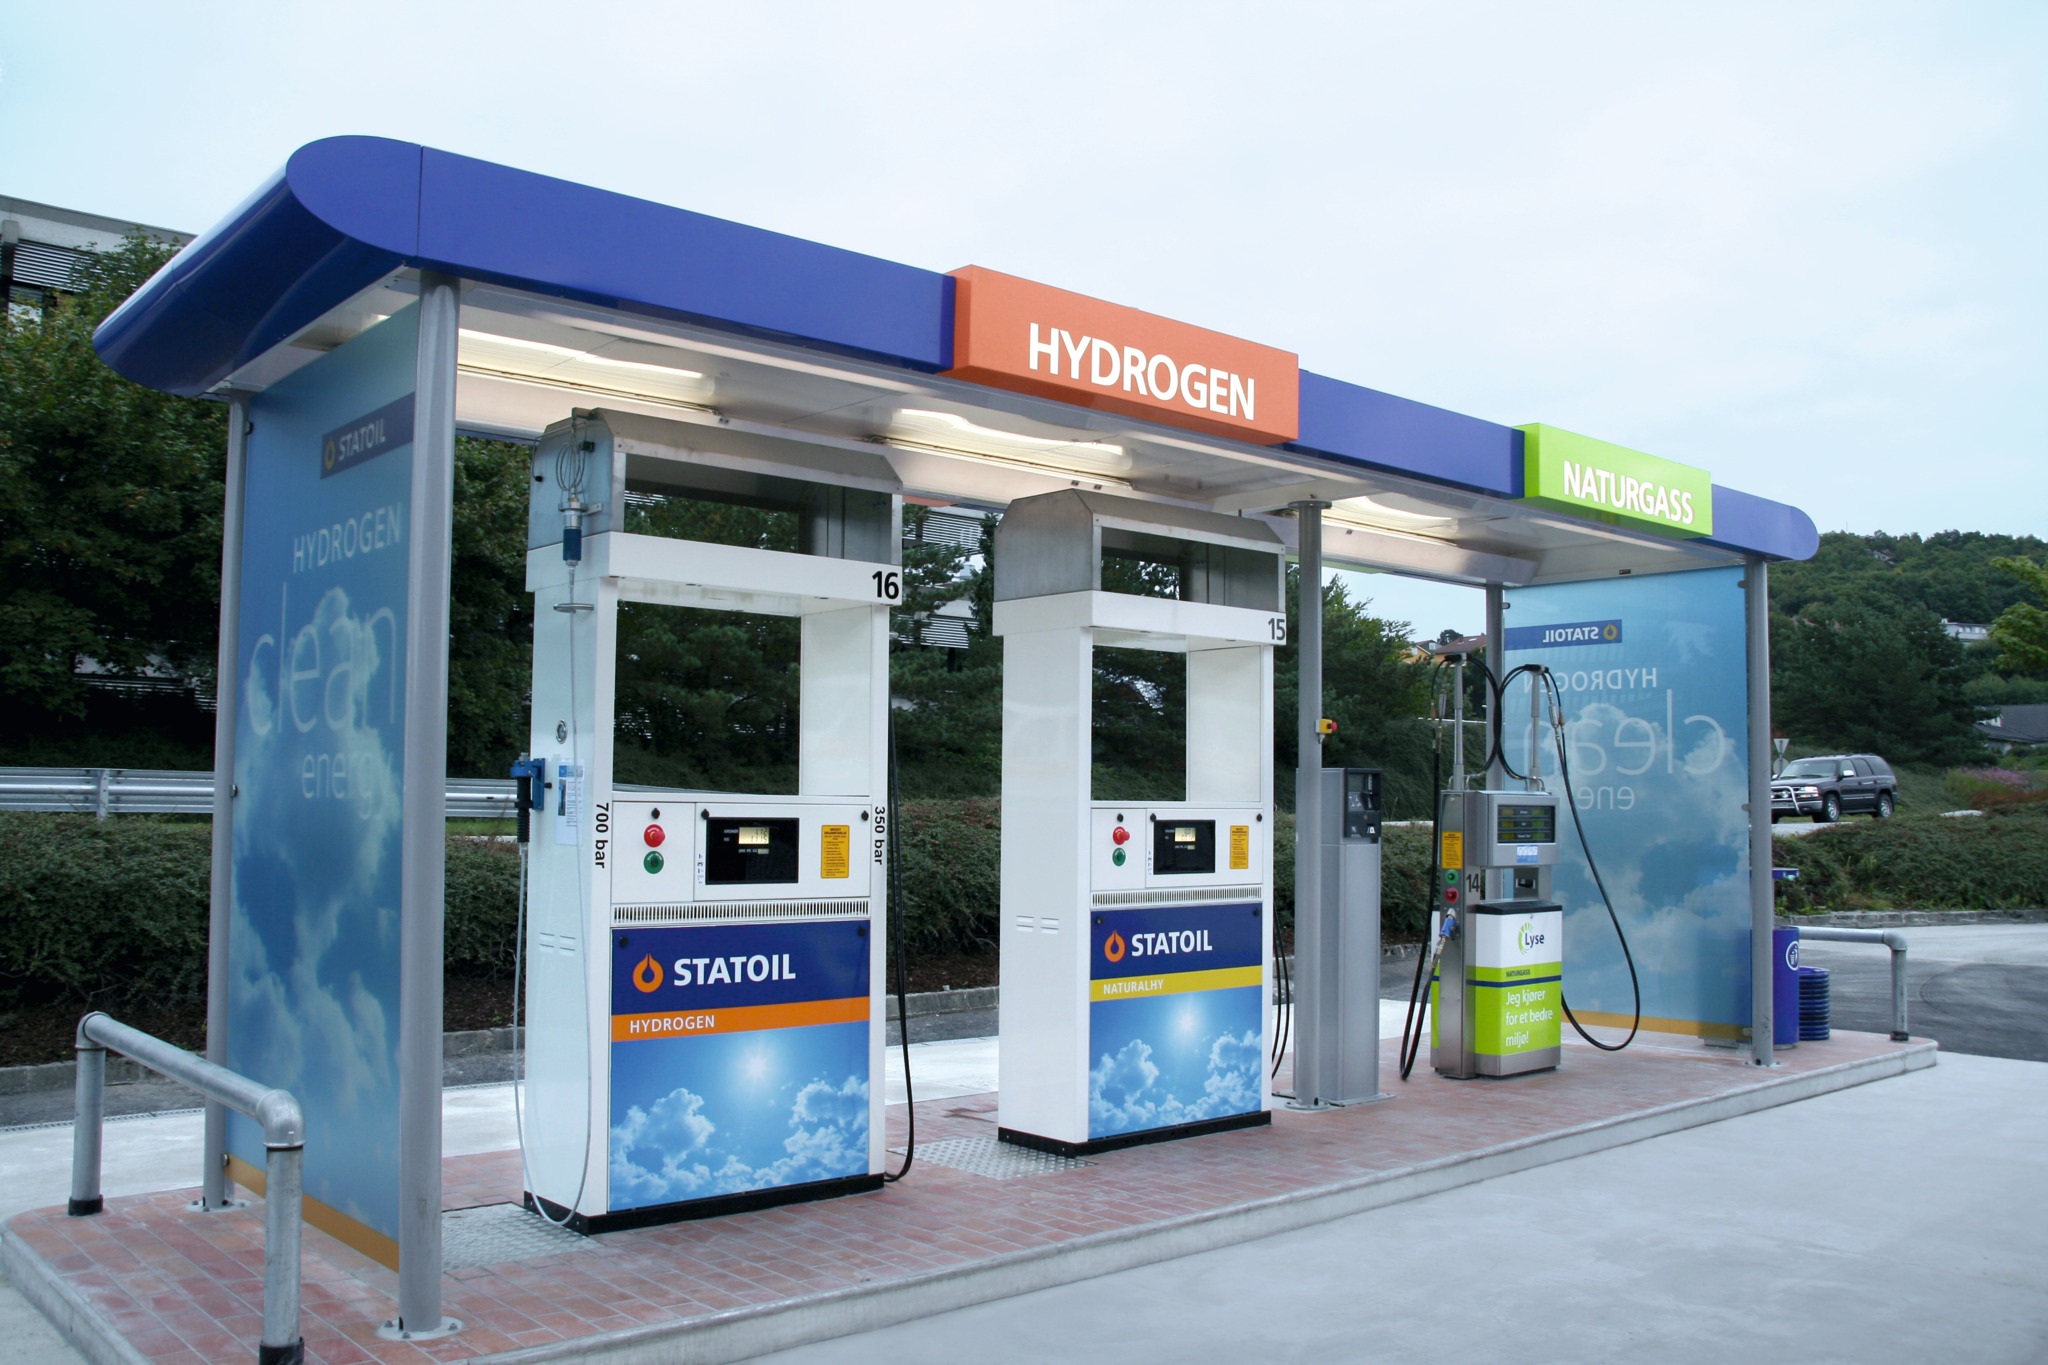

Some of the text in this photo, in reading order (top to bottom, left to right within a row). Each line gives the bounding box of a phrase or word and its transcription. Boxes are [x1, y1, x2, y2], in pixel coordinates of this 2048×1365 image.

[1028, 321, 1256, 422] HYDROGEN
[338, 419, 386, 462] STATOIL
[1563, 460, 1694, 525] NATURGASS
[293, 502, 402, 574] HYDROGEN
[872, 571, 900, 600] 16
[1269, 617, 1286, 641] 15
[246, 582, 397, 737] clean
[594, 803, 609, 869] 700 bar
[874, 806, 886, 866] 350 bar
[1466, 873, 1480, 893] 14
[1131, 929, 1213, 957] STATOIL
[1525, 933, 1545, 948] Lyse
[673, 953, 797, 987] STATOIL
[1103, 979, 1164, 995] NATURALHY
[1506, 989, 1546, 1007] Jeg kjører
[629, 1014, 716, 1034] HYDROGEN
[1506, 1008, 1553, 1026] for et bedre
[1506, 1032, 1528, 1047] miljø!
